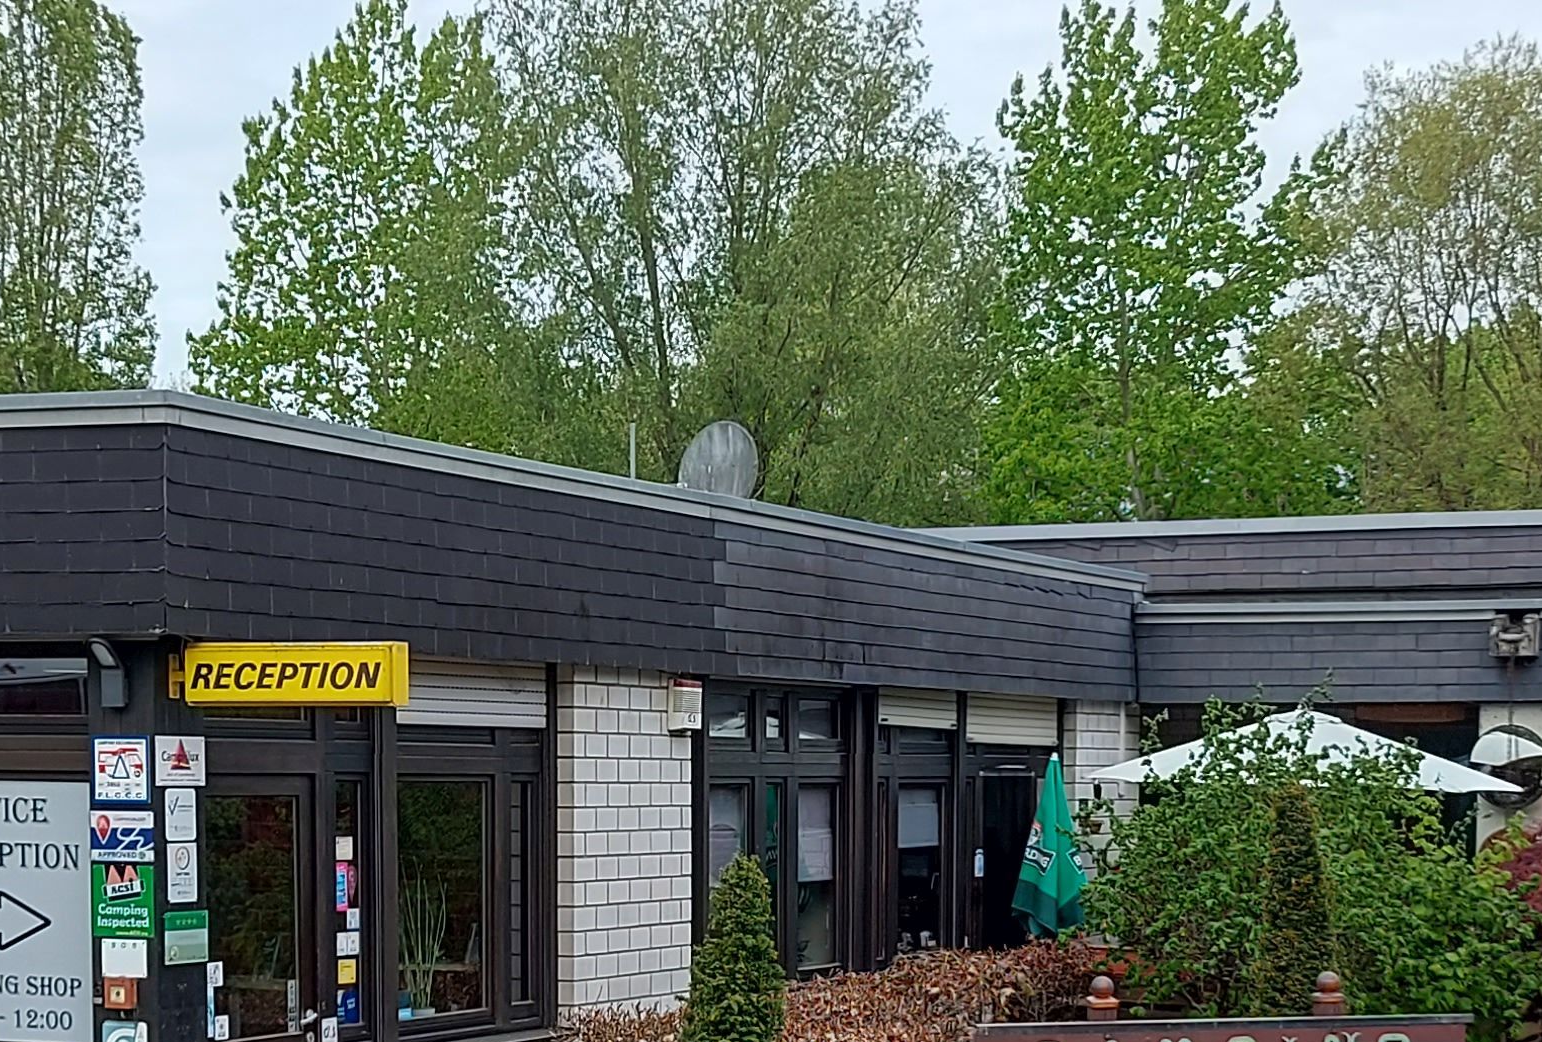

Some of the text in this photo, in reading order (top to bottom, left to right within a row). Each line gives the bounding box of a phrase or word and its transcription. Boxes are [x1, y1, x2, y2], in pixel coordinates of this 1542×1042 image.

[190, 661, 381, 690] RECEPTION
[111, 882, 134, 894] ACSI
[98, 904, 148, 917] Camping
[97, 916, 149, 928] Inspected
[26, 976, 82, 997] SHOP
[14, 1009, 73, 1030] 12:00
